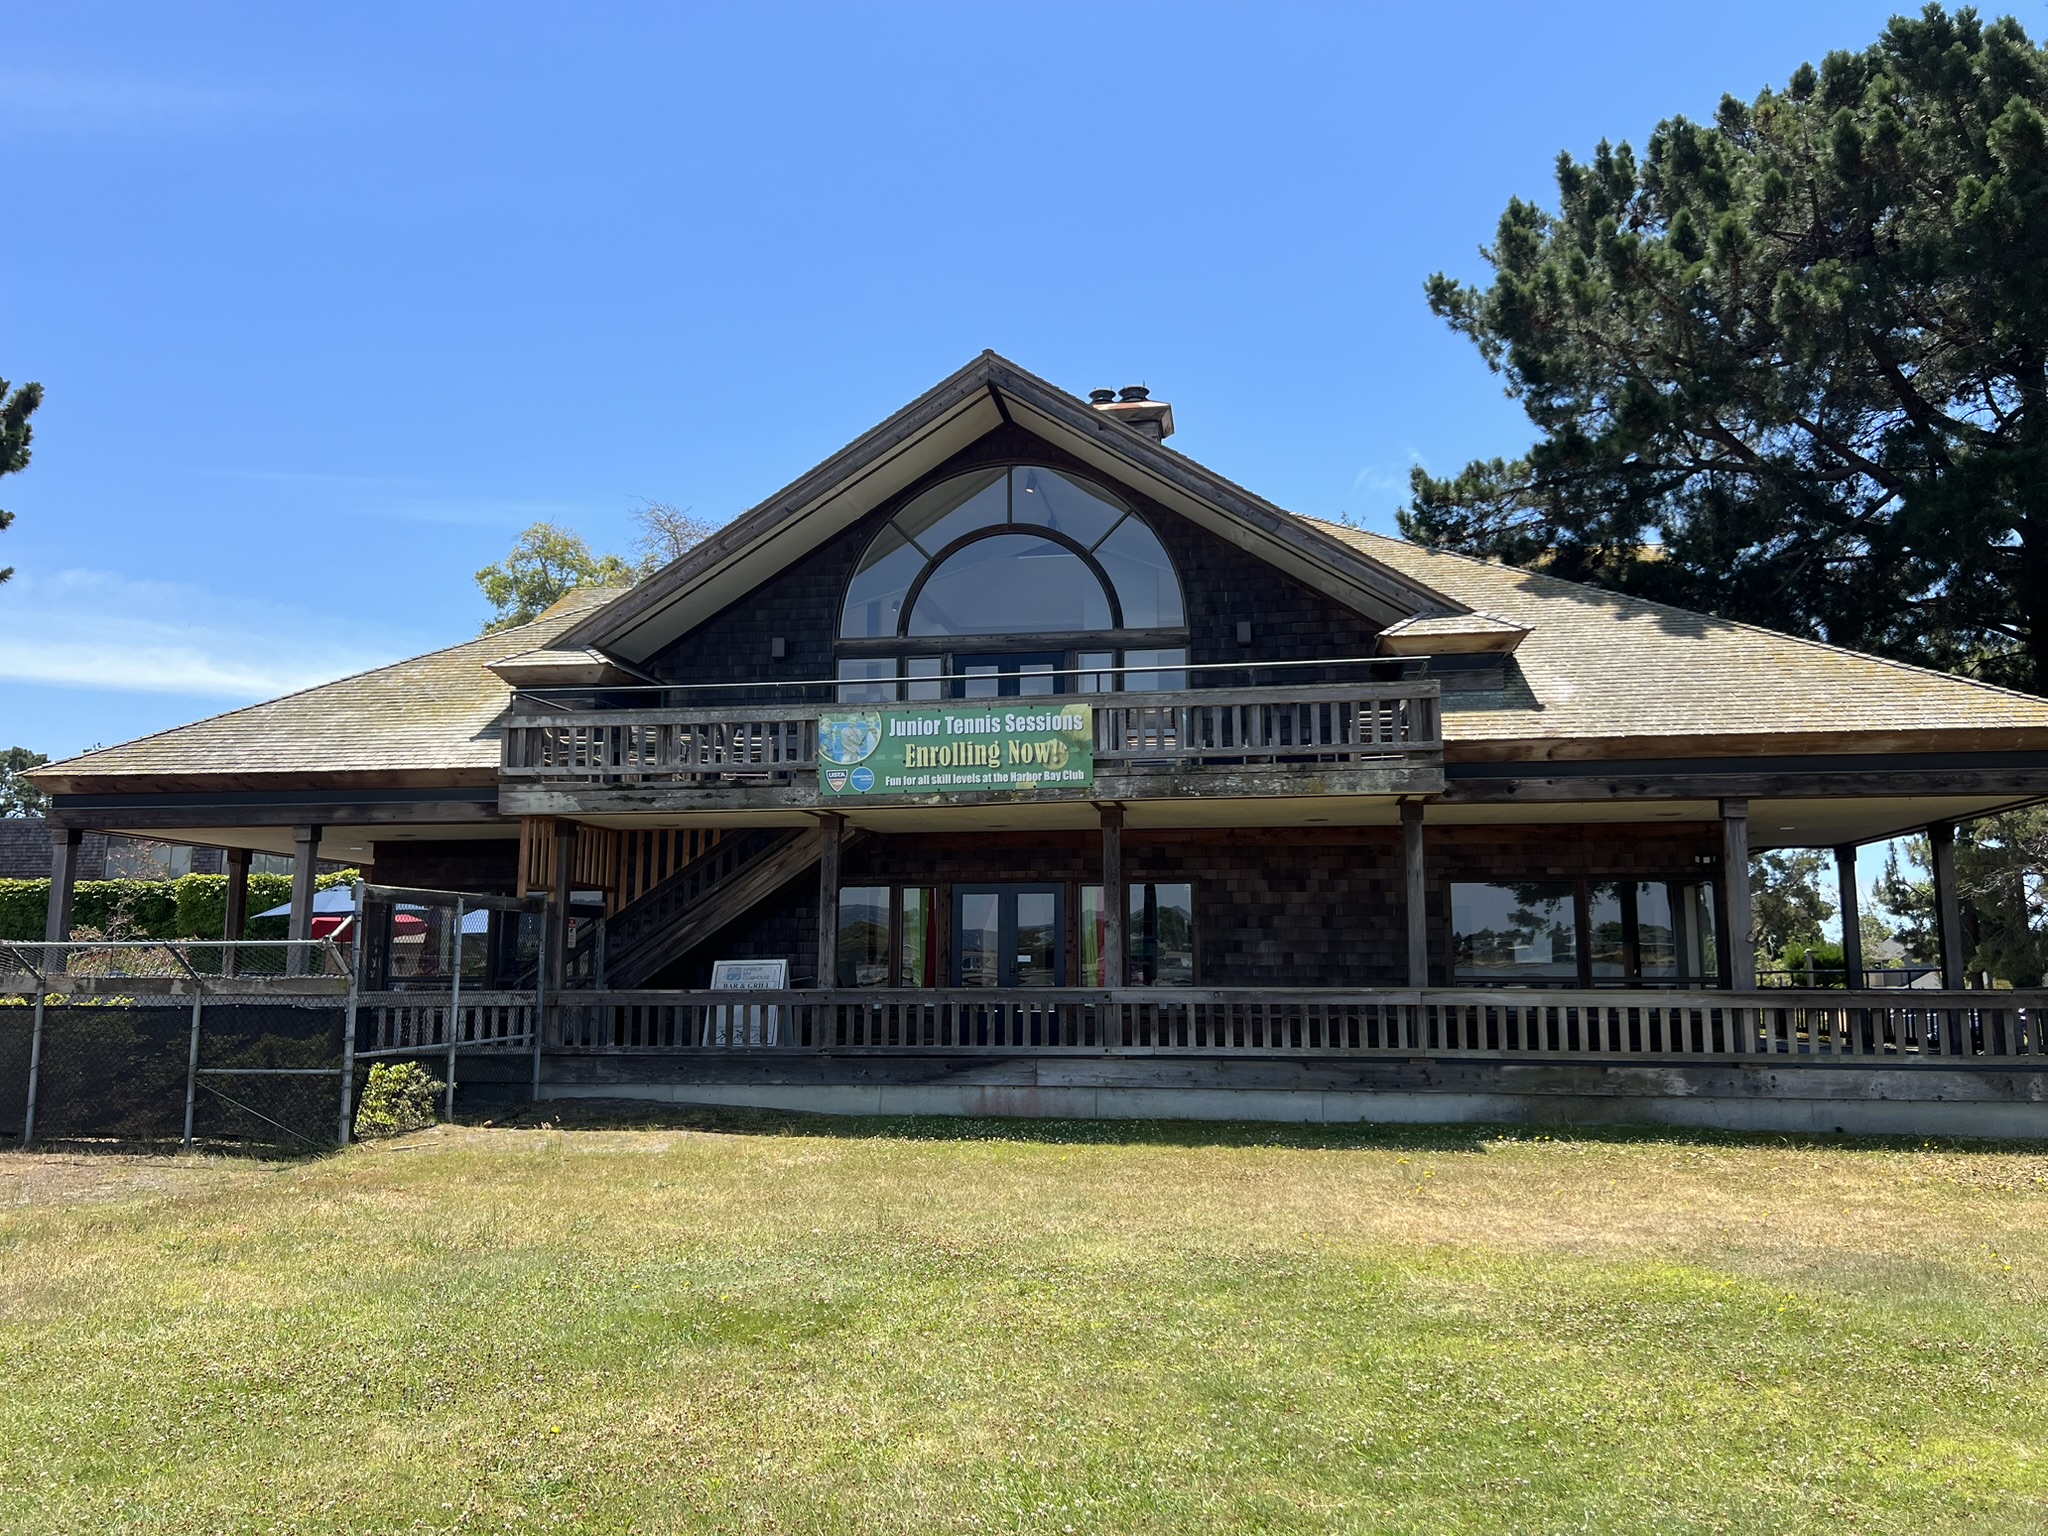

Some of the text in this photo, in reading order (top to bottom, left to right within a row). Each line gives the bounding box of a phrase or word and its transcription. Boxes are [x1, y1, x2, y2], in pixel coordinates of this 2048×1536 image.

[889, 713, 1083, 736] Junior Tennis Sessions
[905, 738, 1057, 768] Enrolling Now!
[886, 770, 1084, 786] Fun for all skill levels at the Harbor Bay Club
